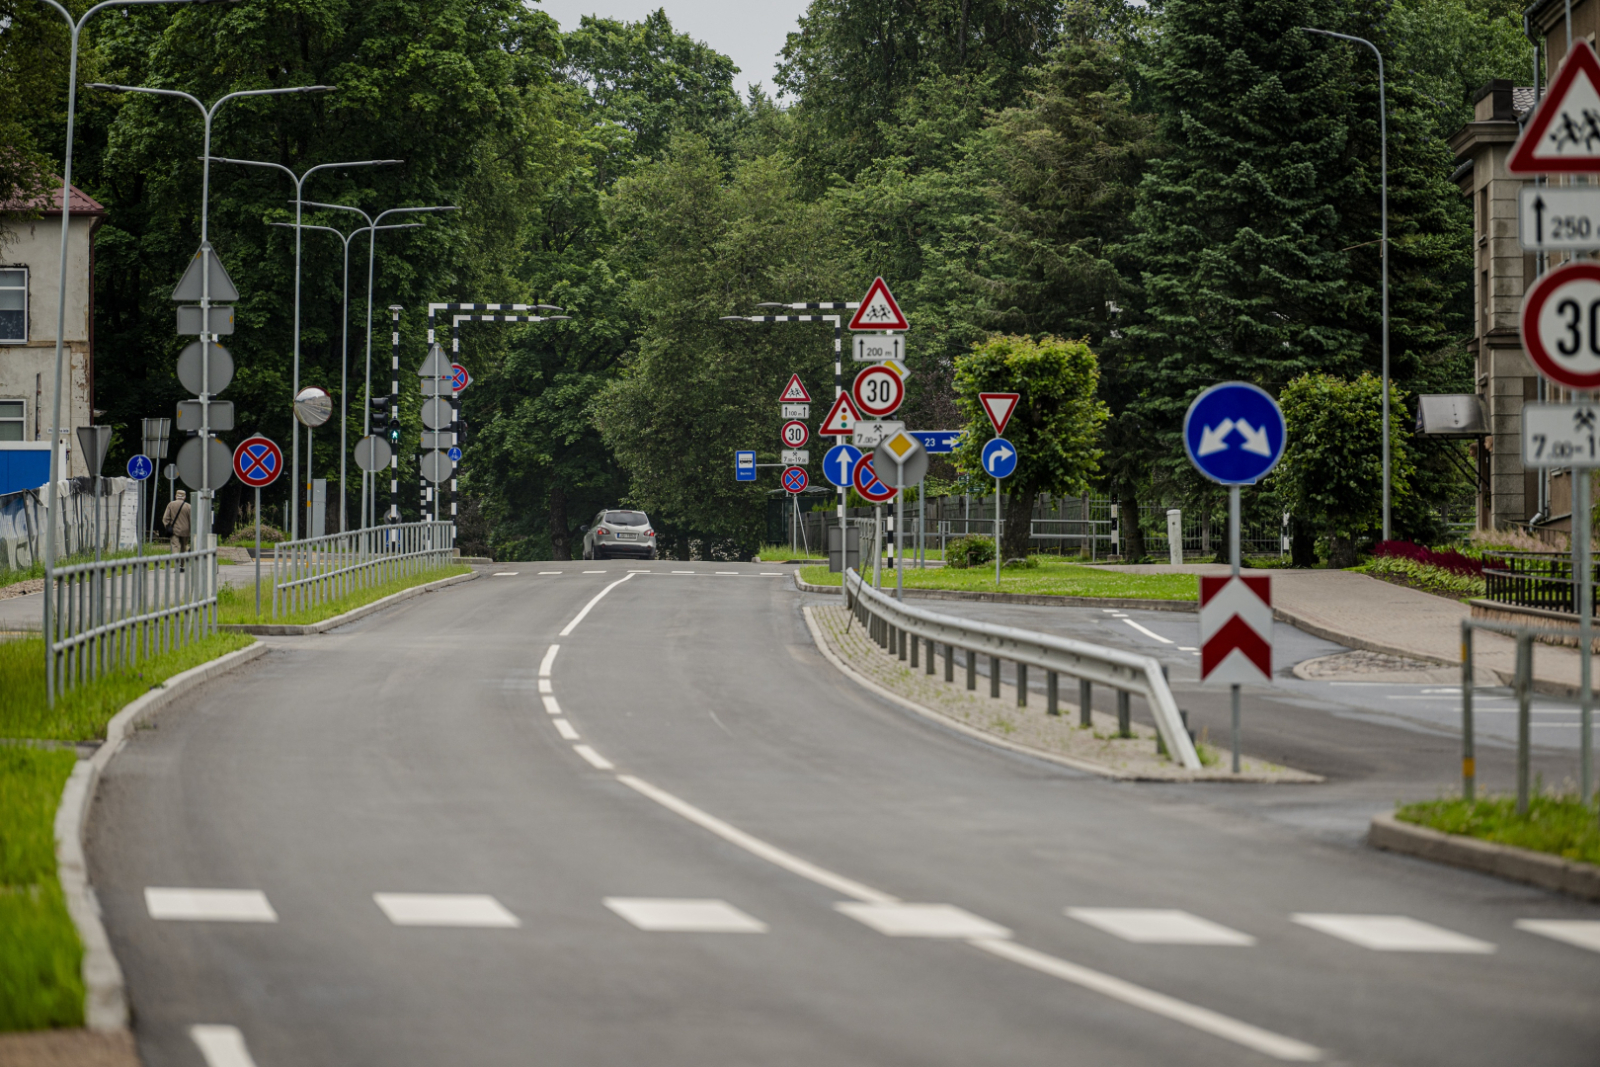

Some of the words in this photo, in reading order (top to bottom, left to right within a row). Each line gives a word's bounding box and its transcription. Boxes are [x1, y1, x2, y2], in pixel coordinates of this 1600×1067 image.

[1551, 215, 1591, 239] 250
[866, 347, 883, 357] 200
[866, 379, 890, 403] 30
[788, 428, 802, 441] 30
[924, 437, 936, 447] 23
[1532, 433, 1600, 459] 7.00-1
